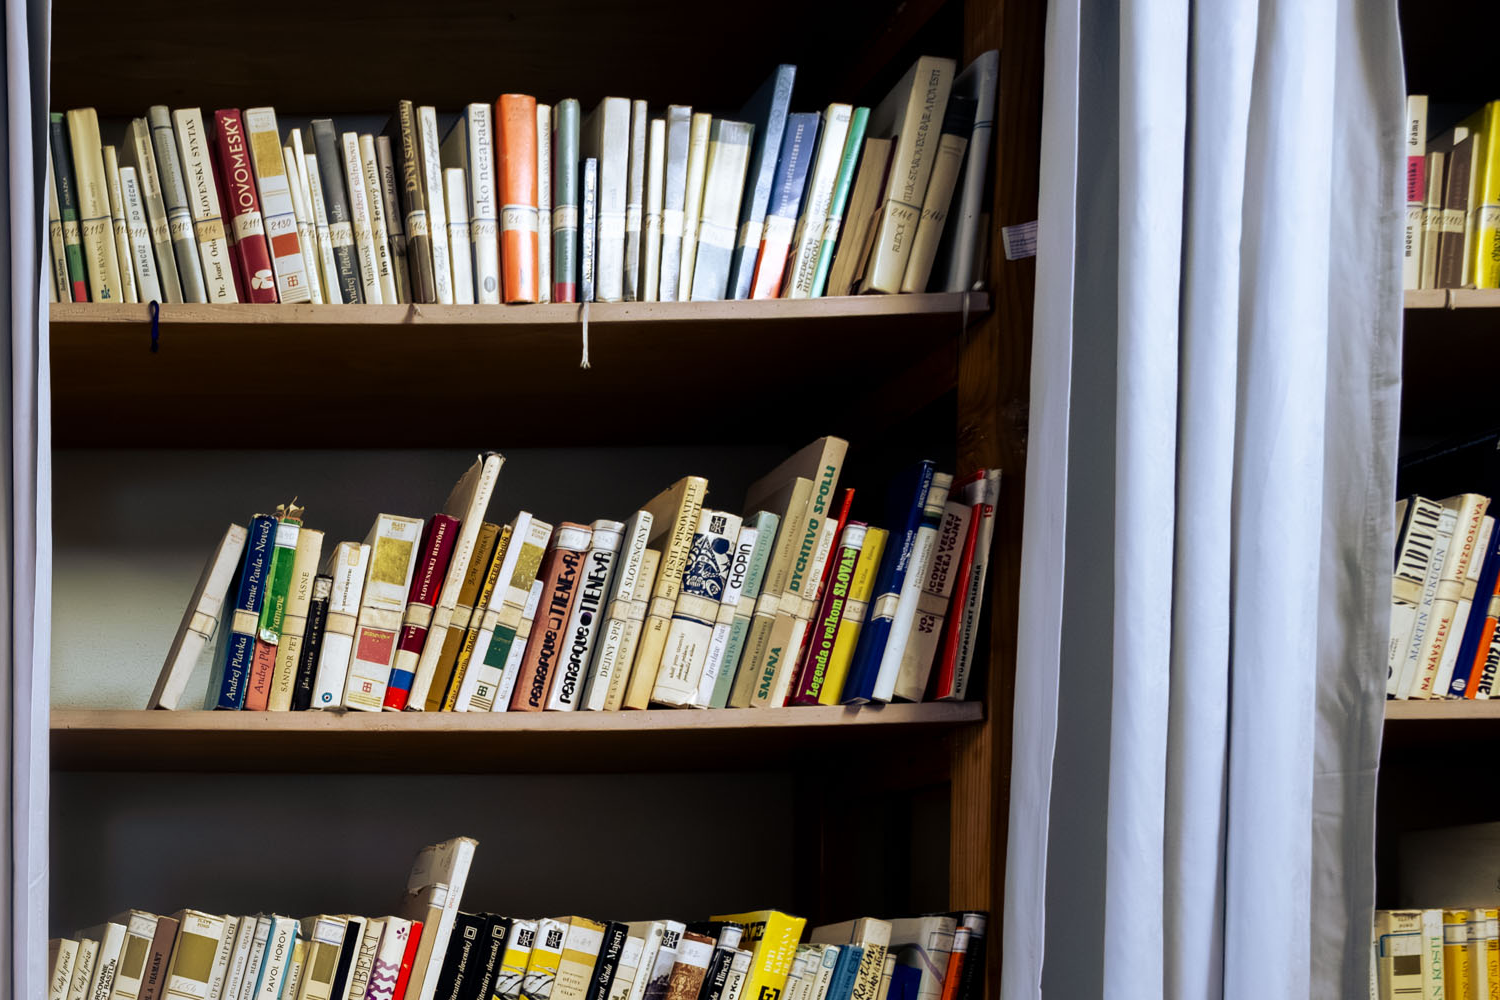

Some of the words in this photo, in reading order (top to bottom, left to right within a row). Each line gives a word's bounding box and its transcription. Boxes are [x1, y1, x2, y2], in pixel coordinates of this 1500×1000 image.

[186, 119, 200, 157] SYNTAX
[473, 110, 489, 180] nezapadá
[127, 179, 137, 207] VRECKA
[193, 162, 211, 216] SLOVENSKÁ
[132, 211, 140, 220] DO
[139, 244, 150, 276] FRANCÚZ
[344, 278, 358, 304] Andrej
[789, 519, 819, 591] DYCHTIVO
[814, 466, 835, 514] SPOLU
[946, 516, 962, 551] VOJNY
[251, 558, 263, 583] Pavla
[258, 520, 271, 552] Novely
[420, 558, 436, 600] SLOVENSKEJ
[433, 522, 446, 556] HISTÓRIE
[731, 544, 751, 589] CHOPIN
[1409, 611, 1429, 660] MARTIN
[1421, 677, 1430, 690] NA
[1426, 618, 1449, 671] NÁVŠTEVE
[226, 670, 240, 701] Andrej
[234, 637, 247, 667] Plávka
[280, 655, 293, 693] SÁNDOR
[600, 645, 615, 678] DEJINY
[758, 647, 781, 700] SMENA
[219, 923, 236, 966] TRIPTYCH
[267, 966, 279, 993] PAVOL
[273, 930, 286, 962] HOROV
[457, 941, 472, 972] slovenskej
